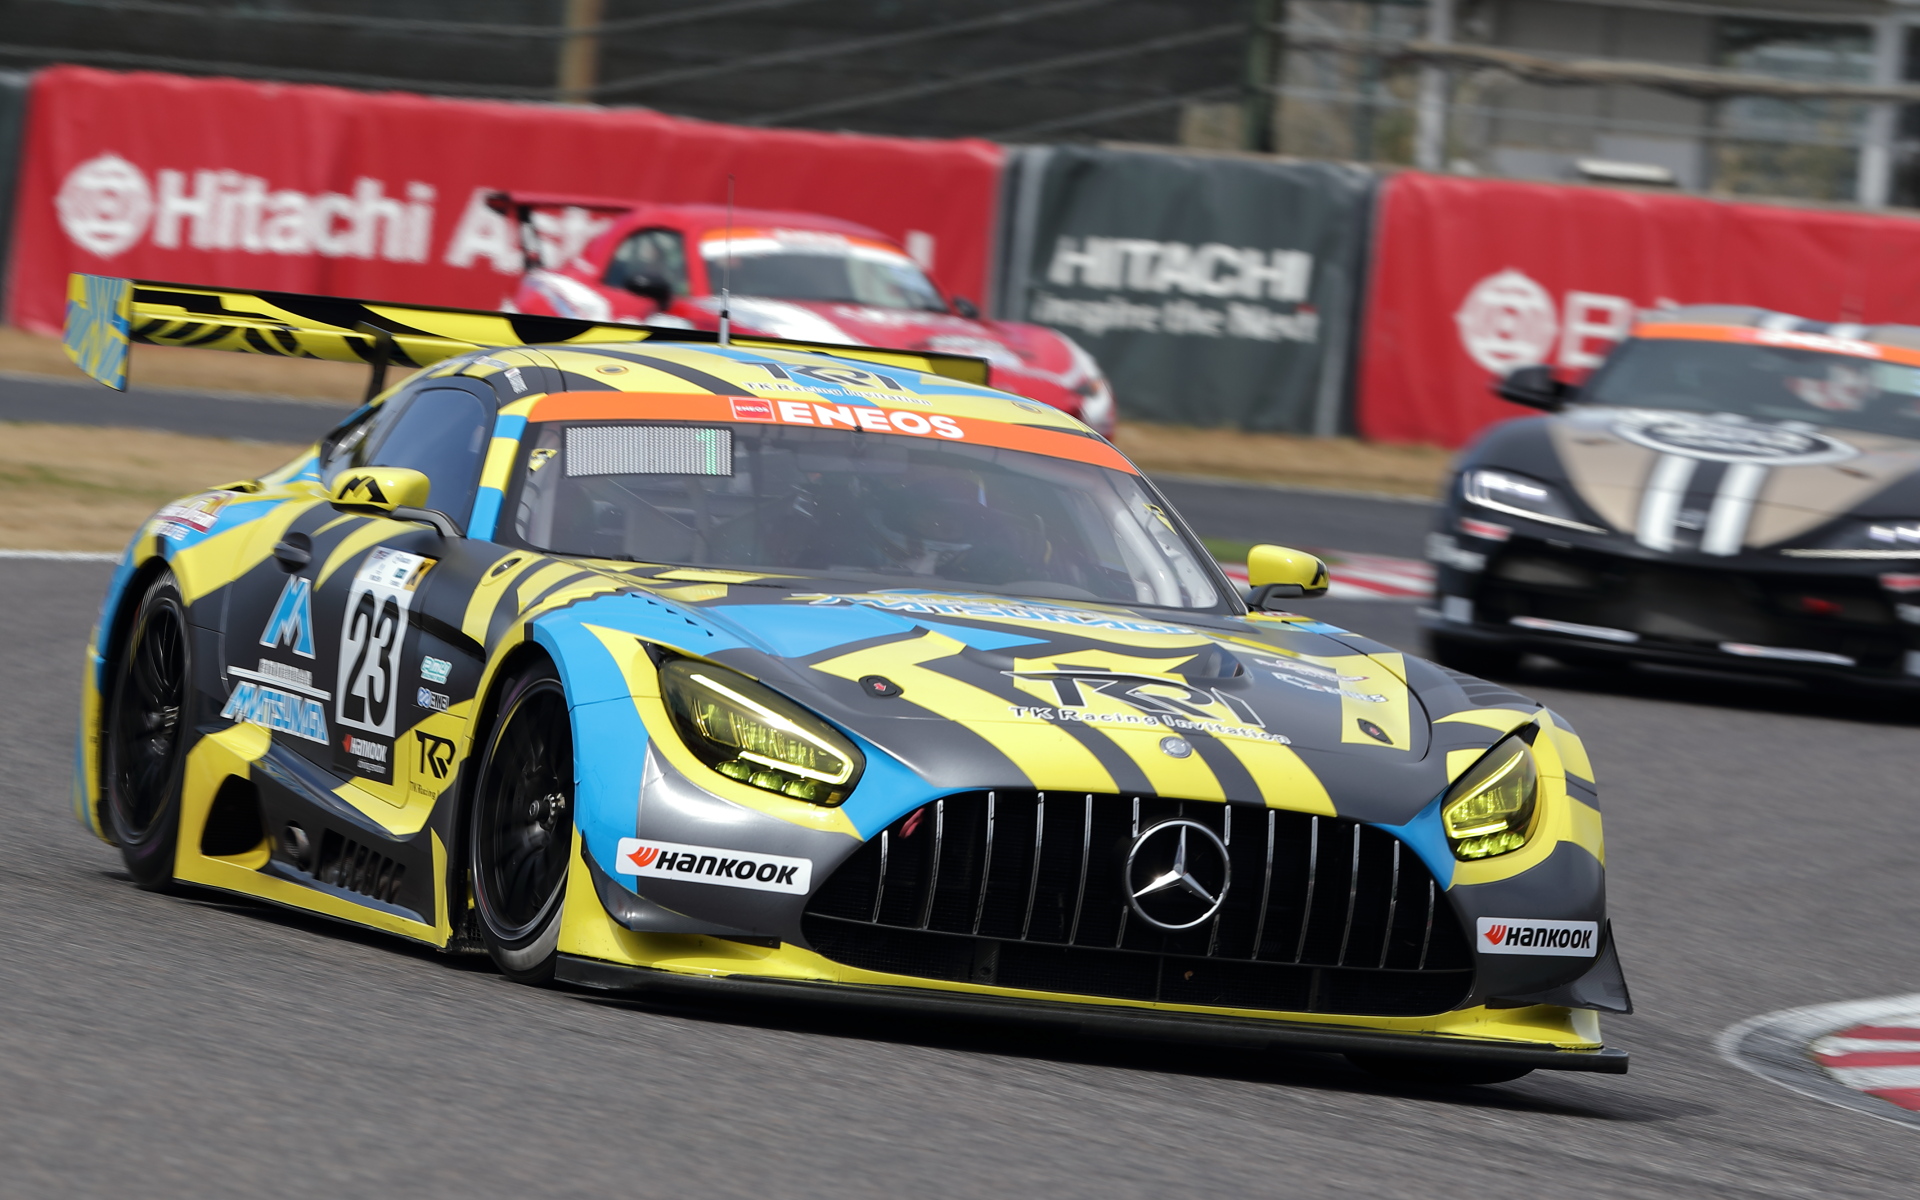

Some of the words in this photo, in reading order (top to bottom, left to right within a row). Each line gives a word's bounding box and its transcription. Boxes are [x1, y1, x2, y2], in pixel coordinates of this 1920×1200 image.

[152, 168, 437, 265] Hitachi
[1048, 235, 1314, 301] HITACHI
[735, 405, 770, 414] ENEOS
[777, 401, 964, 439] ENEOS
[343, 590, 400, 727] 23
[1009, 705, 1052, 720] TK
[1058, 707, 1161, 727] Racing
[1164, 714, 1292, 745] Invitation
